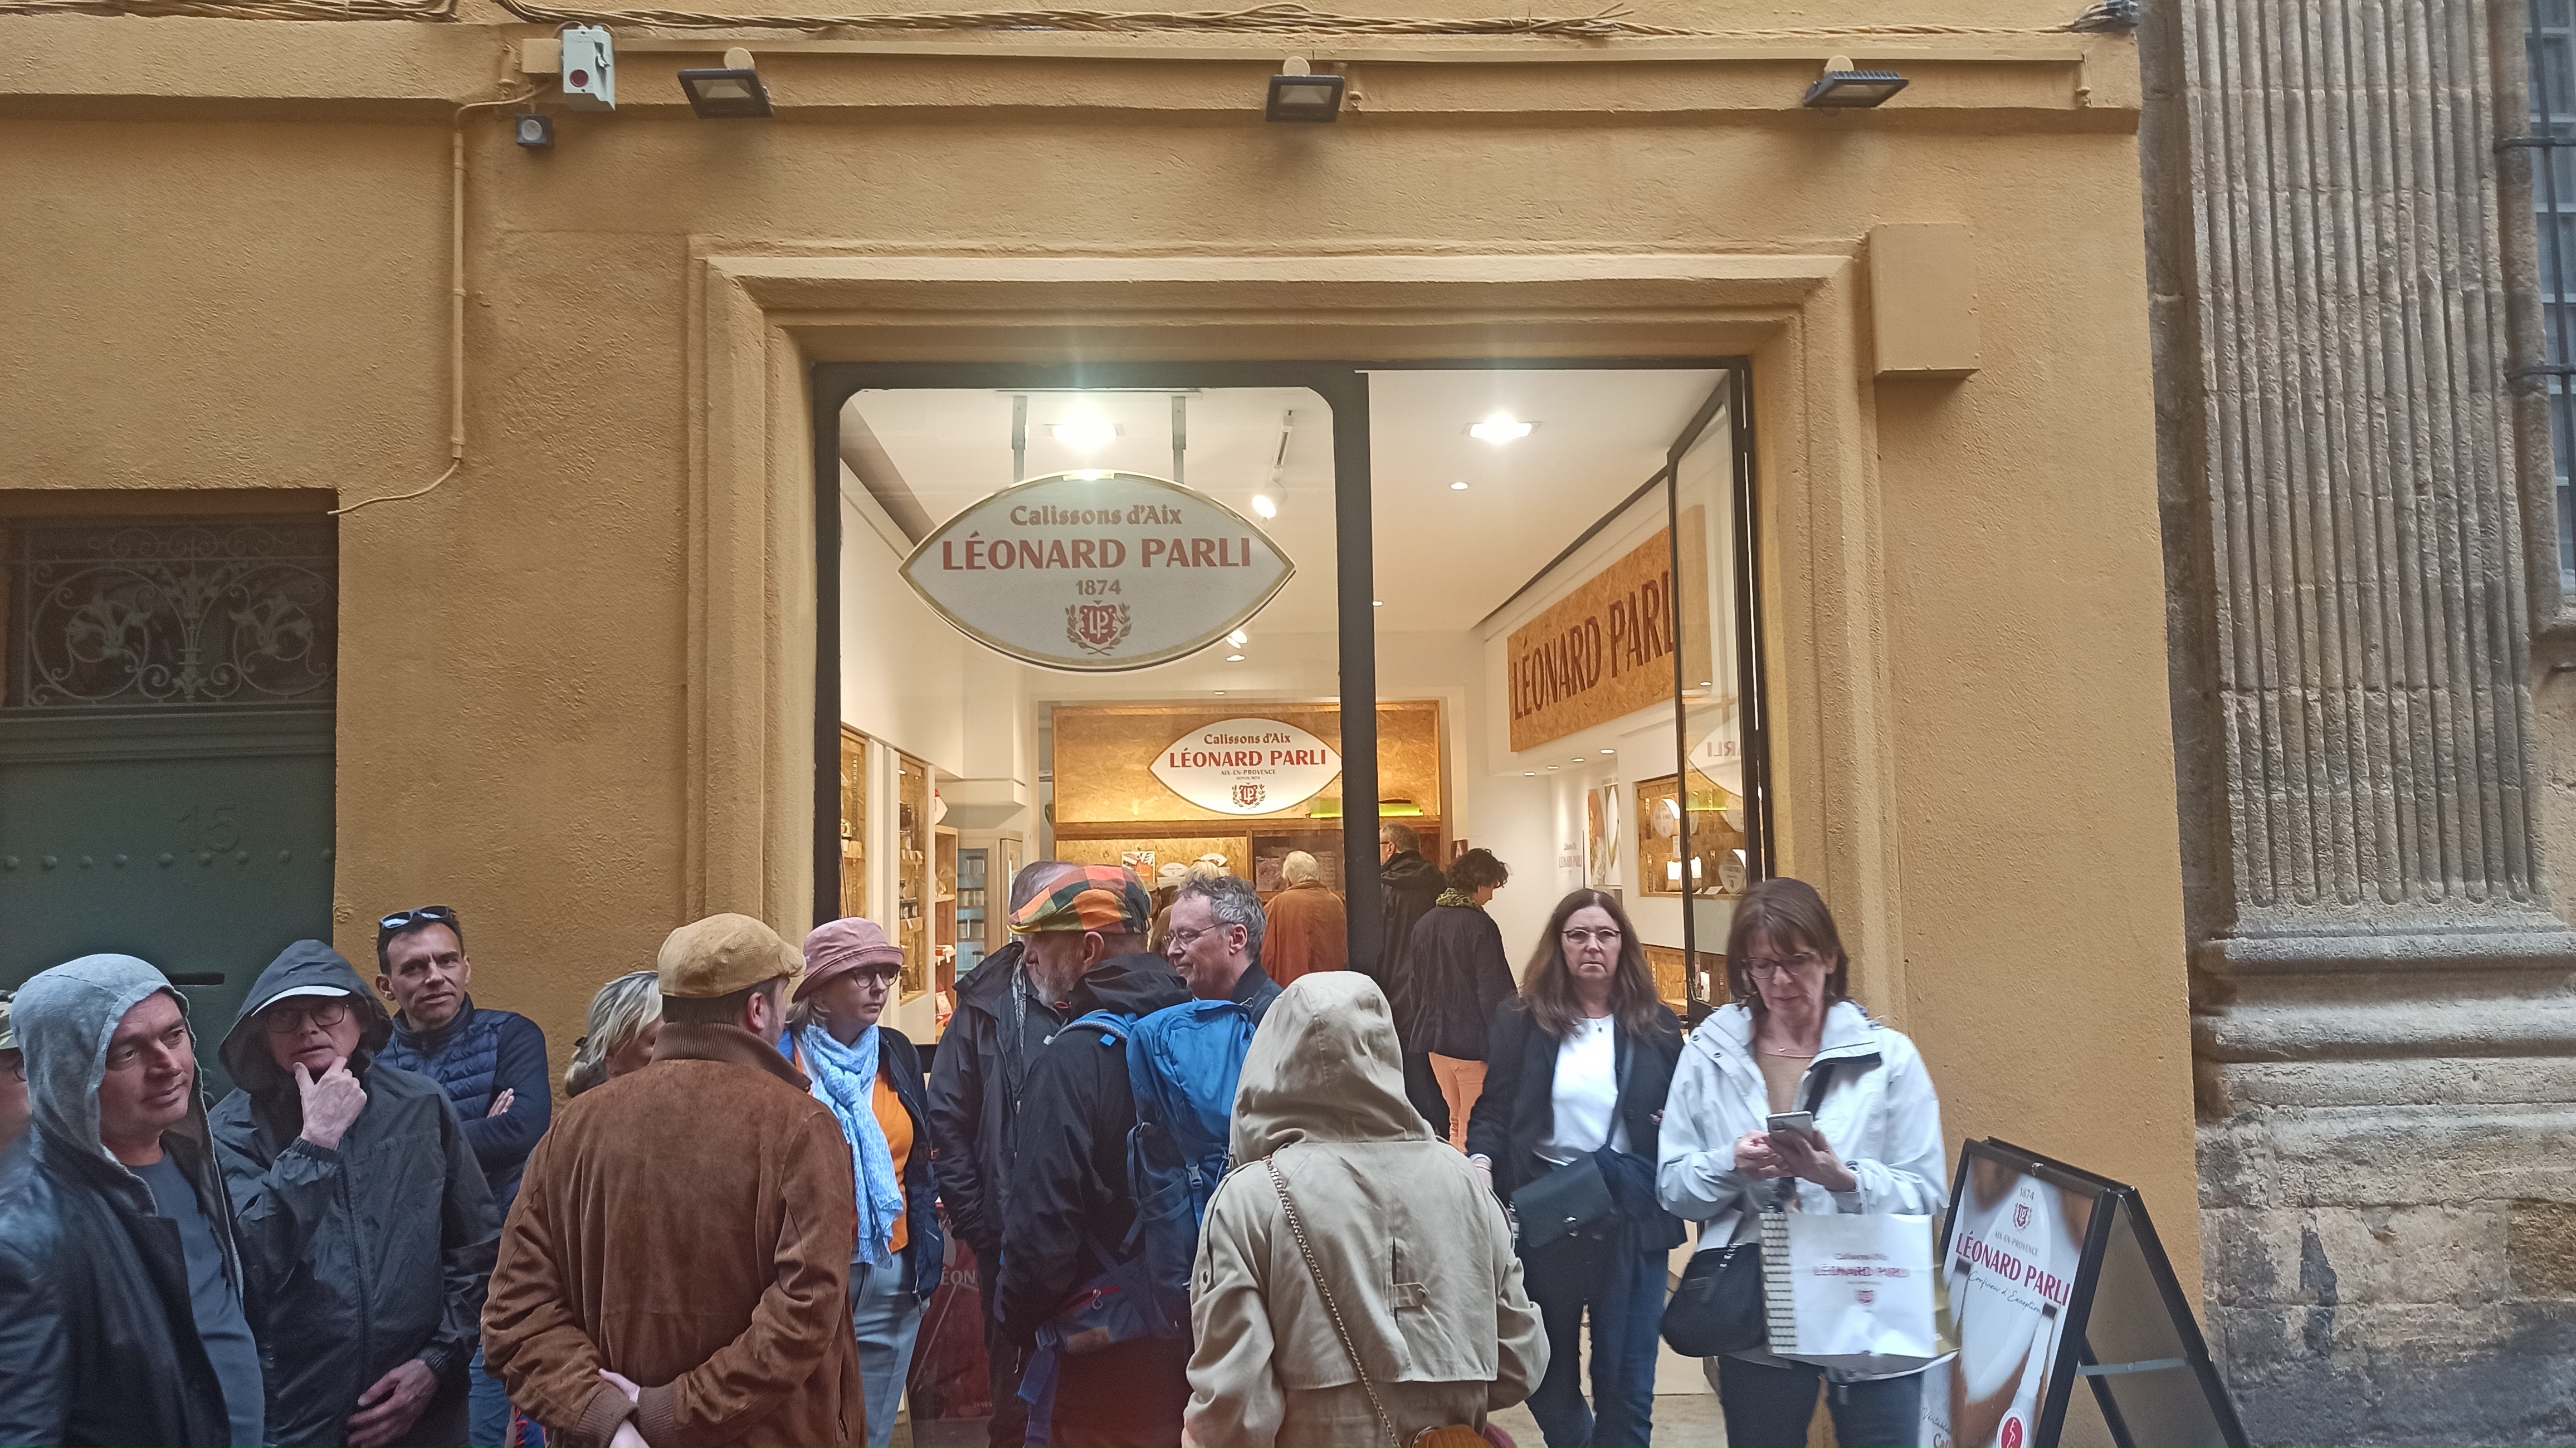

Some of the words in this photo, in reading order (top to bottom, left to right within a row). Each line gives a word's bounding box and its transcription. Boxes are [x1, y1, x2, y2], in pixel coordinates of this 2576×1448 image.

[1009, 505, 1122, 526] Calissons
[1126, 503, 1182, 525] d'Aix
[942, 530, 1126, 570] LÉONARD
[1141, 537, 1251, 568] PARLI
[1076, 579, 1122, 596] 1874
[1513, 615, 1602, 721] LÉONARD
[1609, 570, 1675, 678] PARL
[1203, 733, 1260, 745] Calissons
[1262, 732, 1291, 743] d'Aix
[1169, 747, 1263, 768] LÉONARD
[1270, 749, 1326, 766] PARLI
[2020, 1186, 2035, 1201] 1874
[1995, 1230, 2038, 1257] AIX-EN-PROVENCE
[1955, 1231, 2022, 1281] LÉONARD
[2023, 1264, 2071, 1306] PARLI
